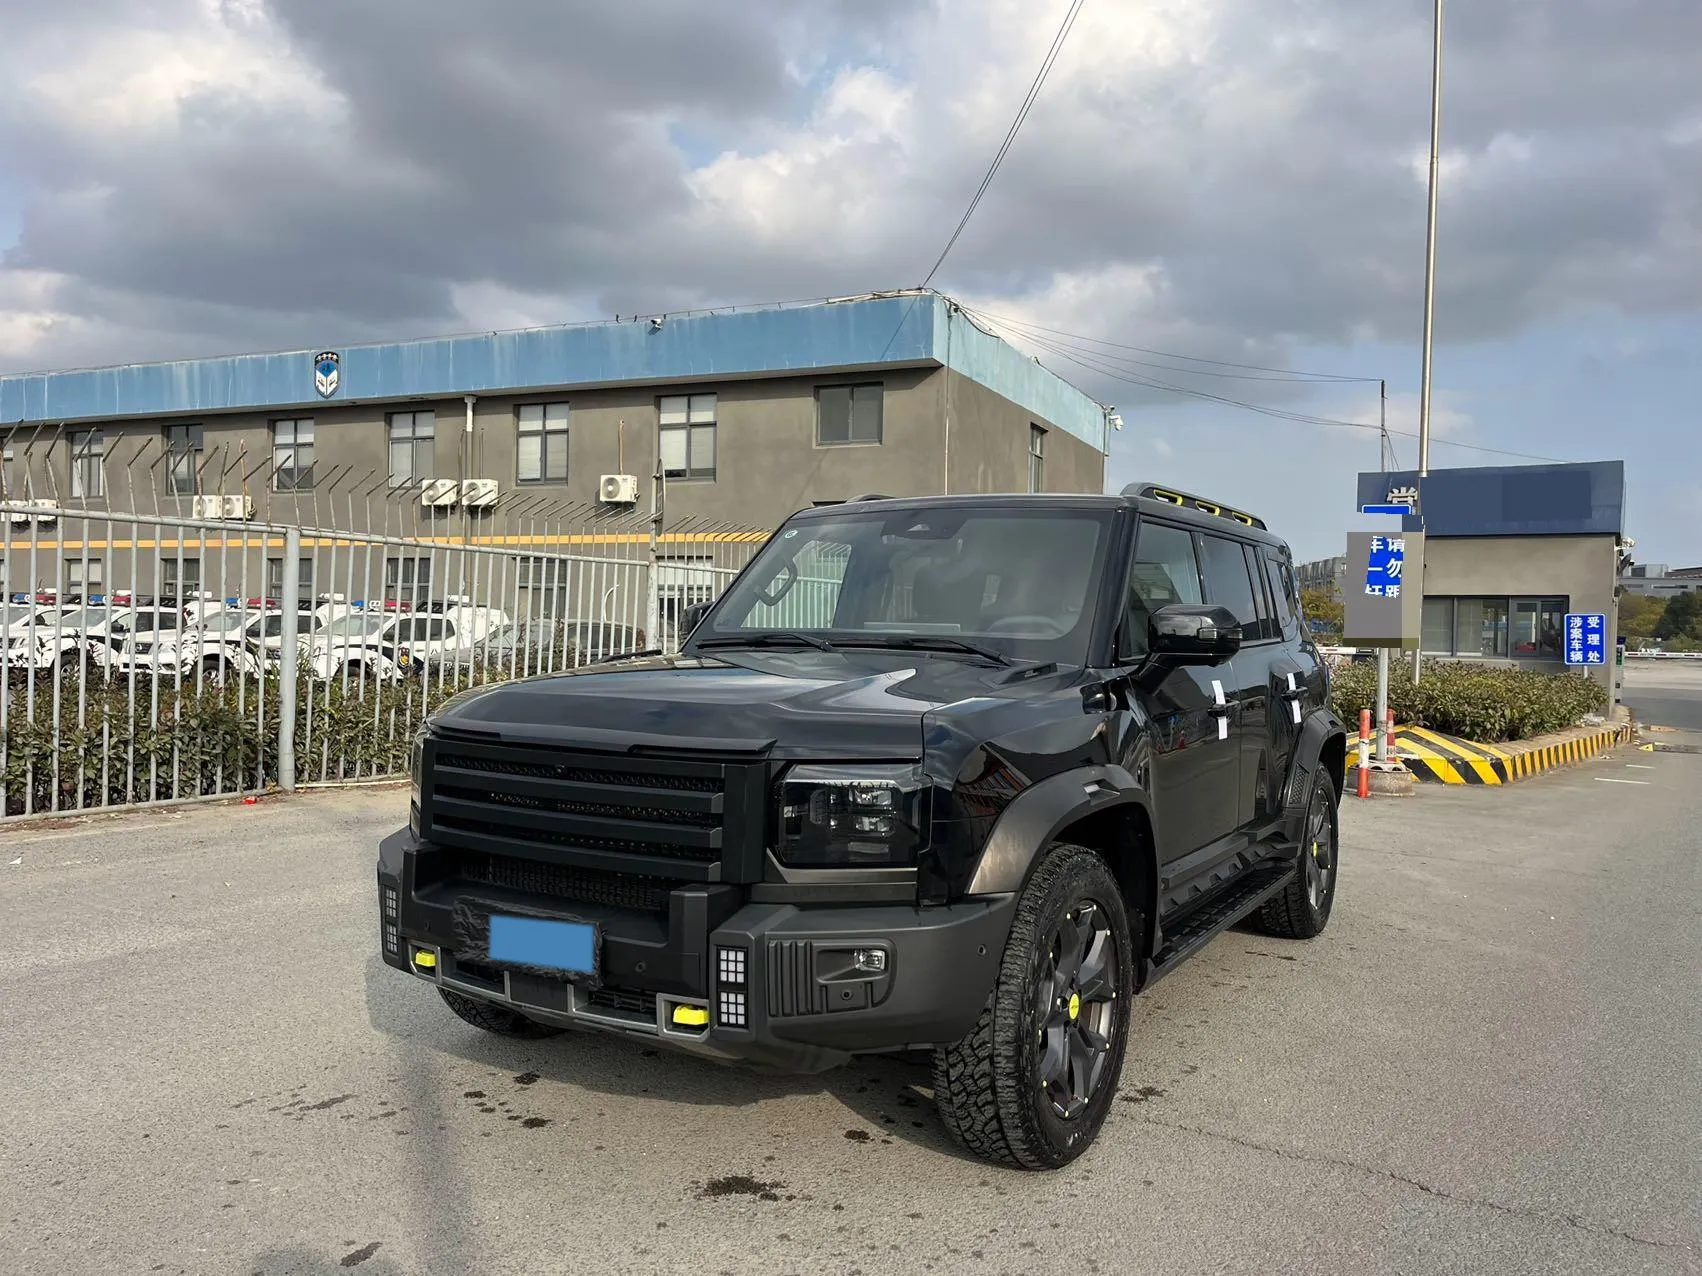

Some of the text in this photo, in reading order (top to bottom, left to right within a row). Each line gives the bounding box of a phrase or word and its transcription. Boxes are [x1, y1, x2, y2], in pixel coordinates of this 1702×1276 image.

[1569, 616, 1583, 662] 涉案车辆
[1587, 616, 1600, 662] 受理处
